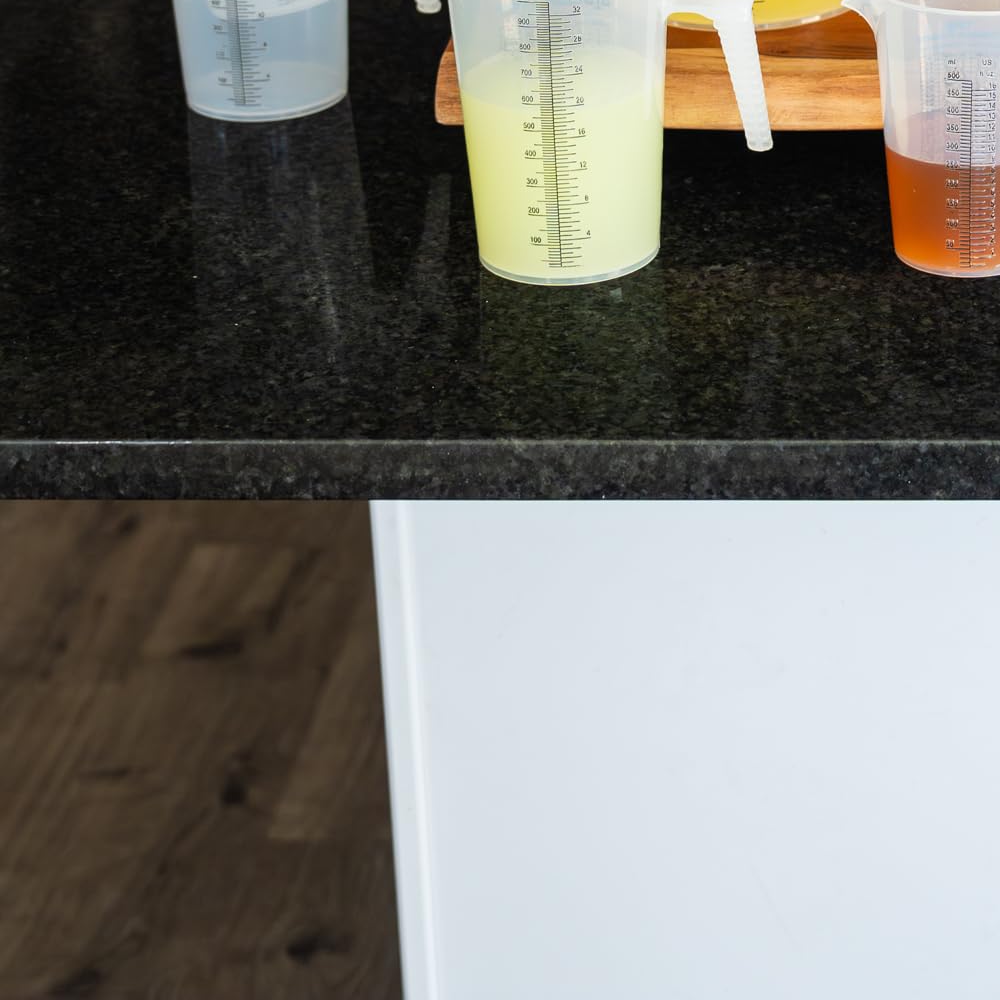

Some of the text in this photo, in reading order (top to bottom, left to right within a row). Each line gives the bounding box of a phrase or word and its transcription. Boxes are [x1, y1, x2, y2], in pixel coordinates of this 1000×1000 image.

[948, 72, 960, 80] 500
[576, 96, 584, 104] 20
[946, 106, 959, 114] 400
[524, 122, 534, 130] 500
[946, 124, 959, 132] 350
[946, 142, 958, 150] 300
[528, 206, 540, 214] 200
[530, 236, 542, 244] 100
